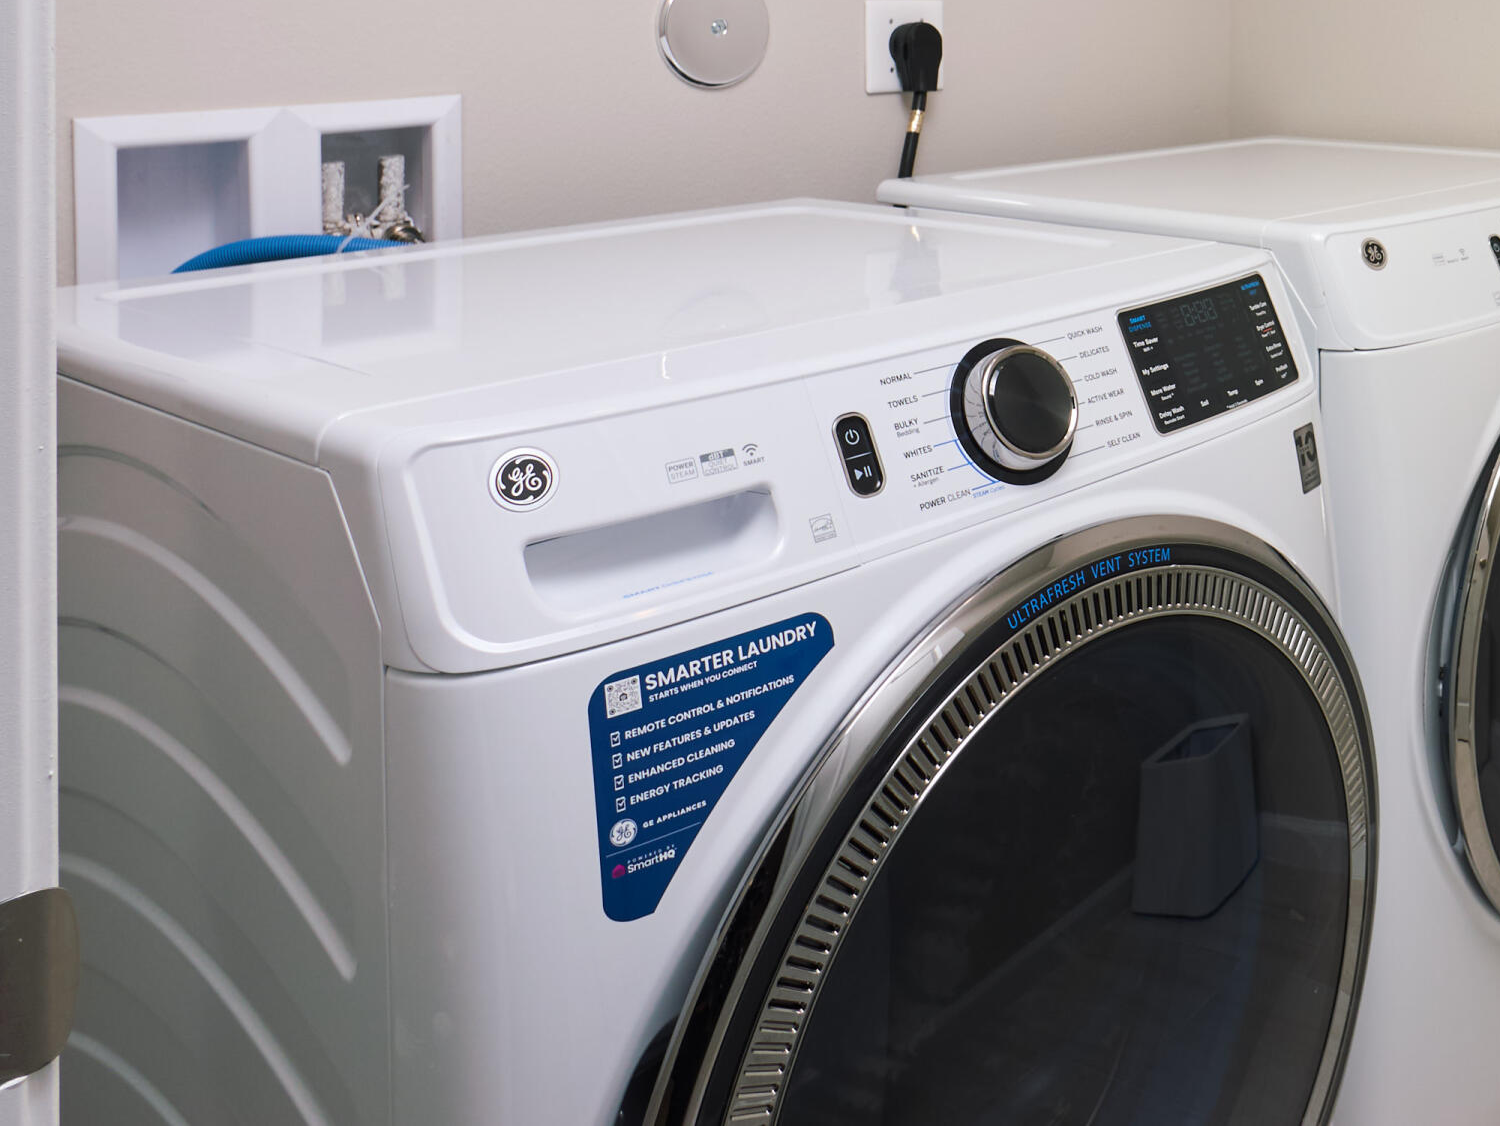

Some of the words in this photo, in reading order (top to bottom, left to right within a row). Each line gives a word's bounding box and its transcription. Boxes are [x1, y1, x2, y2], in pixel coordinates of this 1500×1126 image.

[1067, 330, 1085, 340] QUICK
[1086, 325, 1103, 336] WASH
[1079, 345, 1110, 359] DELICATES
[1084, 372, 1100, 382] COLD
[1101, 368, 1117, 378] WASH
[1142, 368, 1150, 376] My
[1150, 363, 1169, 374] Settings
[880, 372, 912, 386] NORMAL
[888, 395, 918, 409] TOWELS
[1087, 393, 1107, 404] ACTIVE
[1108, 388, 1124, 399] WEAR
[894, 418, 918, 431] BULKY
[1095, 416, 1113, 426] RINSE
[1119, 410, 1133, 420] SPIN
[897, 427, 920, 438] Bedding
[1107, 438, 1121, 448] SELF
[1122, 432, 1140, 443] CLEAN
[904, 444, 933, 459] WHITES
[668, 461, 694, 473] POWER
[743, 456, 766, 467] SMART
[670, 469, 696, 480] STEAM
[704, 464, 737, 476] CONTROL
[911, 466, 945, 482] SANITIZE
[920, 496, 947, 511] POWER
[947, 489, 971, 503] CLEAN
[1007, 570, 1086, 630] ULTRAFRESH
[1091, 556, 1121, 579] VENT
[1128, 547, 1171, 568] SYSTEM
[645, 649, 735, 691] SMARTER
[737, 621, 818, 662] LAUNDRY
[649, 690, 679, 703] STARTS
[680, 679, 704, 693] WHEN
[704, 673, 721, 686] YOU
[722, 660, 758, 681] CONNECT
[624, 719, 667, 740] REMOTE
[668, 702, 716, 726] CONTROL
[716, 699, 725, 709] &
[725, 674, 795, 705] NOTIFICATIONS
[626, 746, 651, 762] NEW
[653, 729, 702, 753] FEATURES
[703, 725, 712, 736] &
[713, 710, 755, 733] UPDATES
[628, 757, 685, 784] ENHANCED
[686, 738, 736, 763] CLEANING
[630, 784, 671, 806] ENERGY
[673, 764, 724, 790] TRACKING
[642, 820, 655, 829] GE
[656, 800, 707, 823] APPLIANCES
[627, 848, 662, 864] POWERED
[627, 848, 676, 874] SmartHQ
